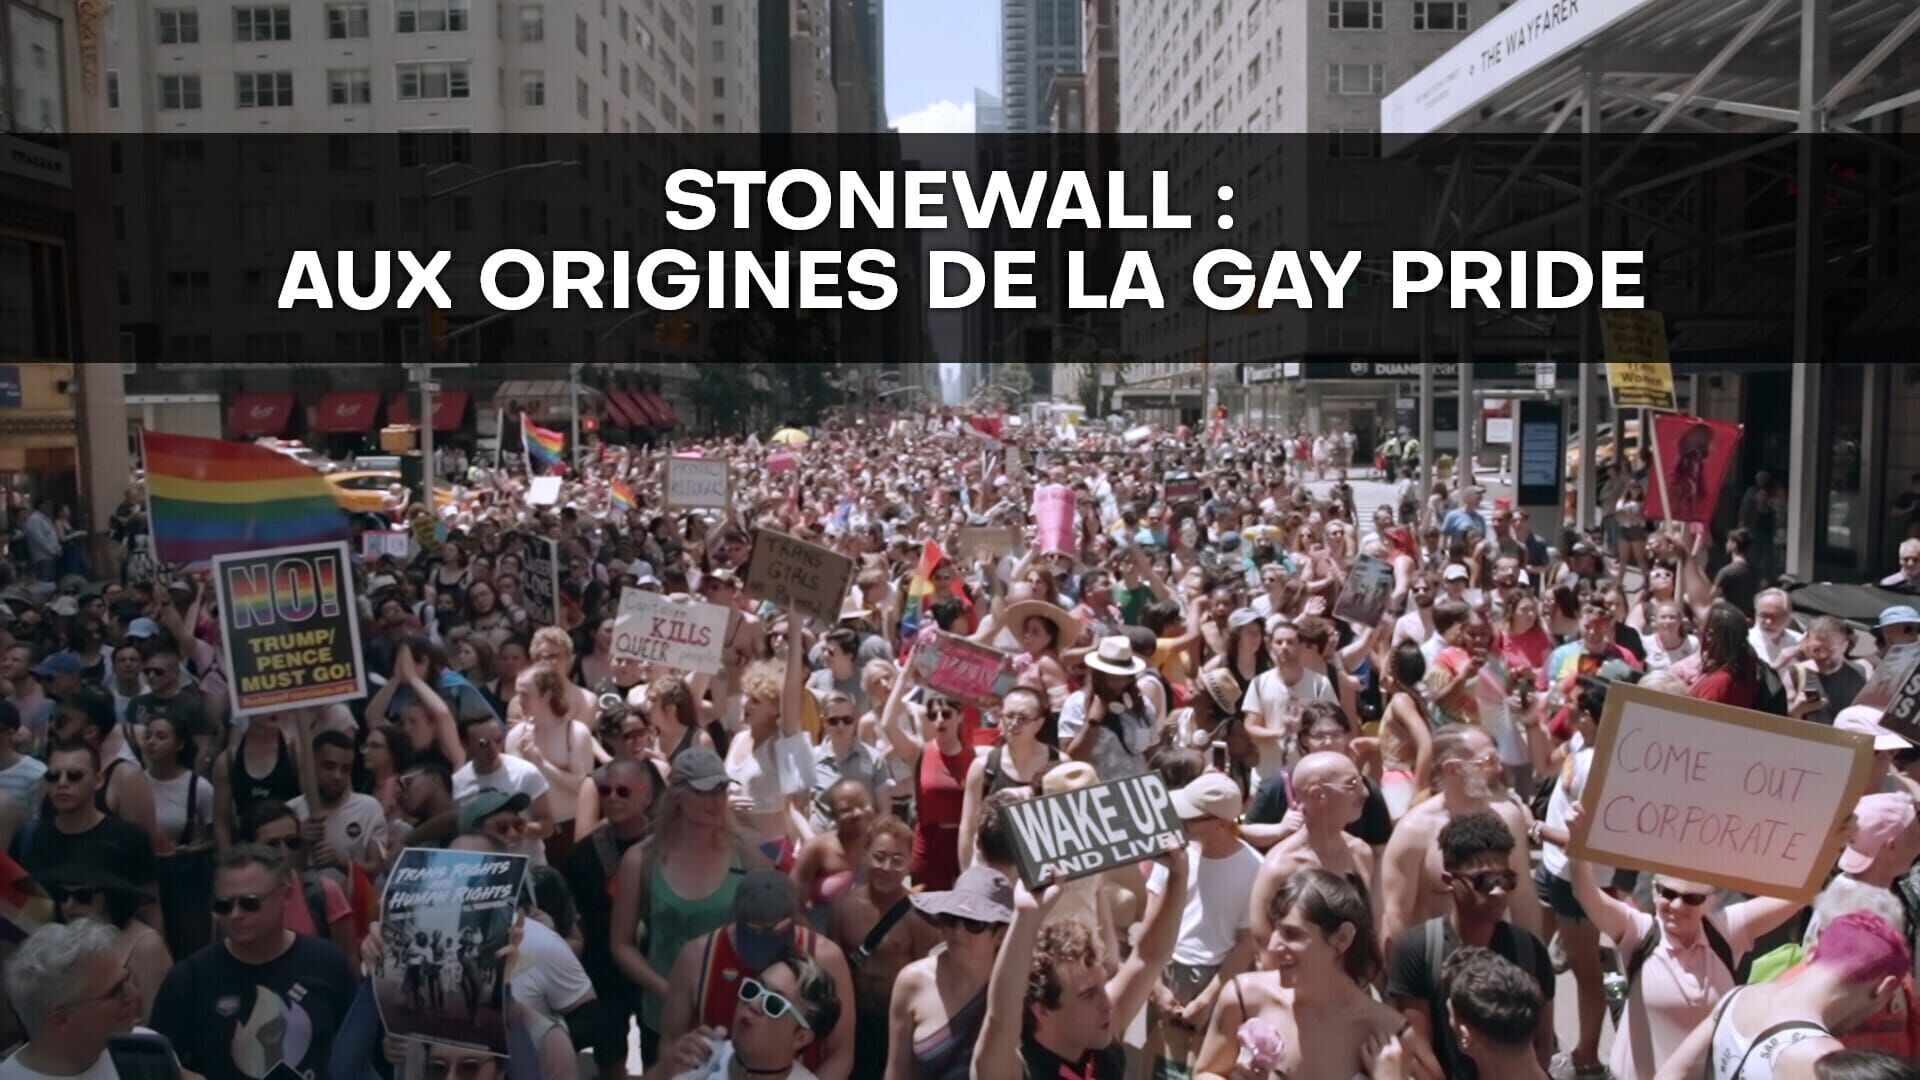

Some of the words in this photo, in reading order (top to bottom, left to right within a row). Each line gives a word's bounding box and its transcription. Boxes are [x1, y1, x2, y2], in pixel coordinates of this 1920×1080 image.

[1481, 41, 1502, 71] THE
[1506, 0, 1578, 55] WAYFARER
[764, 538, 822, 568] TRANS
[768, 560, 820, 592] GIRLS
[228, 556, 340, 630] NO!
[249, 628, 336, 653] TRUMP/
[615, 632, 670, 662] QUEER
[649, 616, 712, 647] KILLS
[256, 646, 333, 672] PENCE
[241, 669, 306, 693] MUST
[312, 663, 352, 683] GO!
[1617, 727, 1711, 783] COME
[1743, 761, 1823, 804] OUT
[1009, 785, 1128, 863] WAKE
[1117, 774, 1168, 835] UP
[1603, 795, 1808, 860] CORPORATE
[1038, 850, 1104, 882] AND
[1111, 829, 1185, 862] LIVE!
